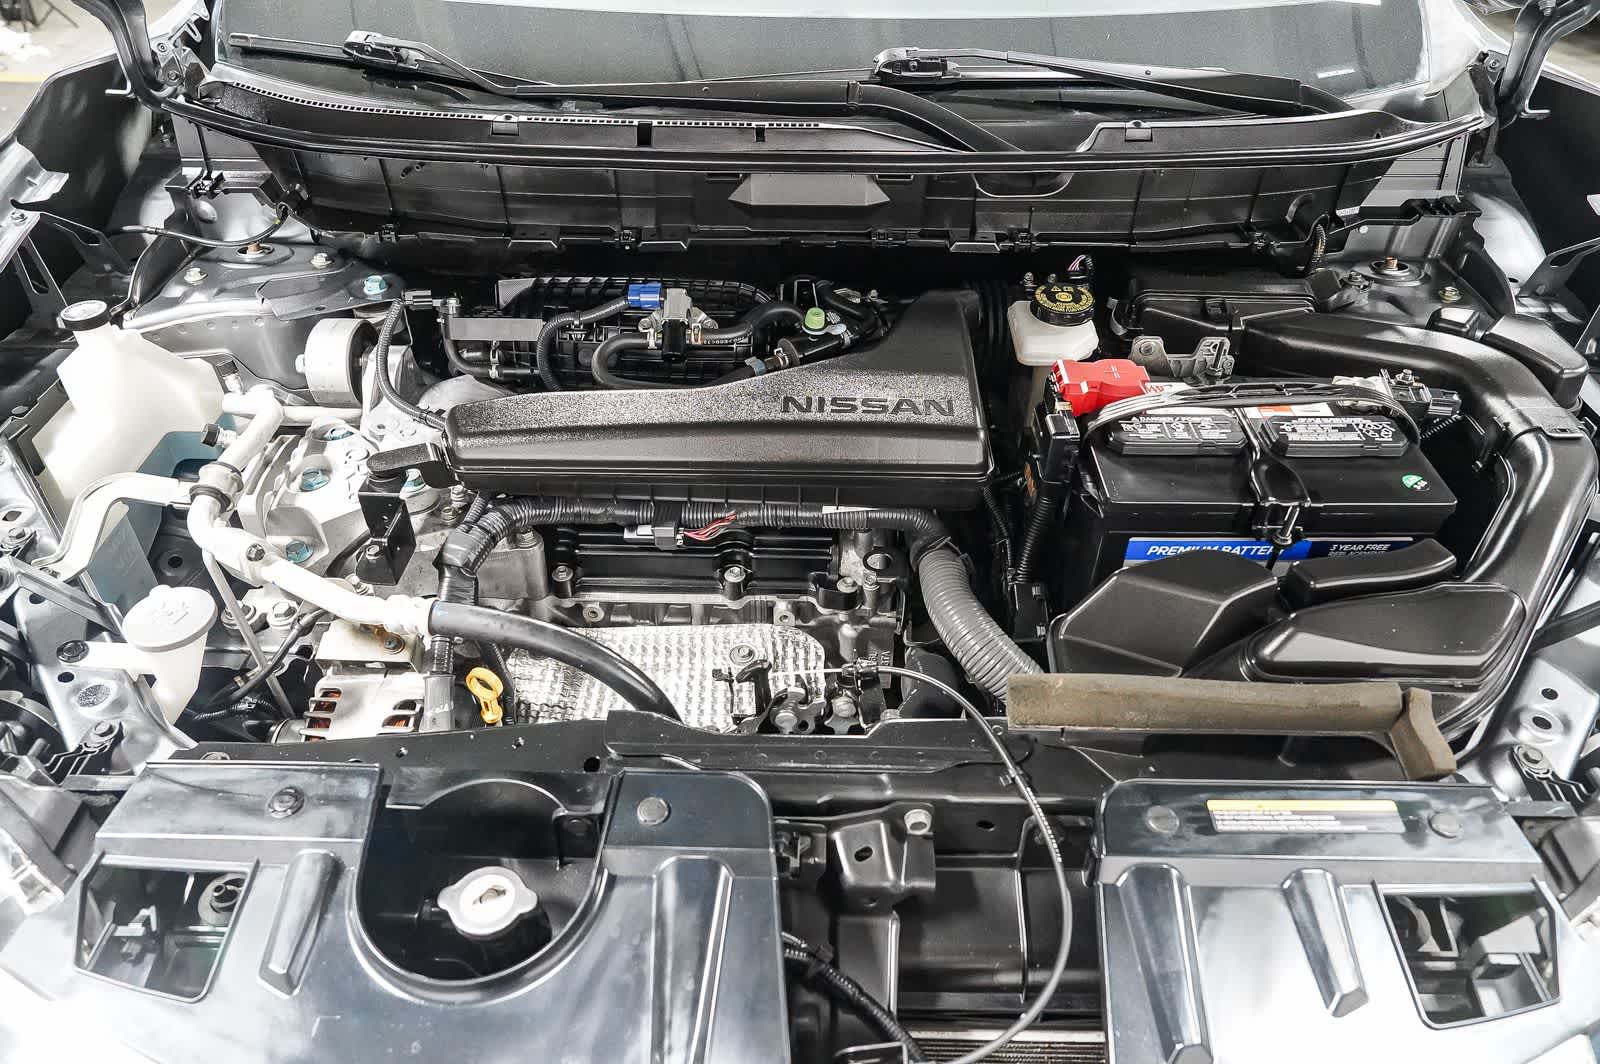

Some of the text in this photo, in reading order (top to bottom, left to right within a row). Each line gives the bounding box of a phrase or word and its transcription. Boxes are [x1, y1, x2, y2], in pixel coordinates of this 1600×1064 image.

[781, 396, 954, 416] NISSAN
[1330, 543, 1391, 551] 3 YEAR FREE
